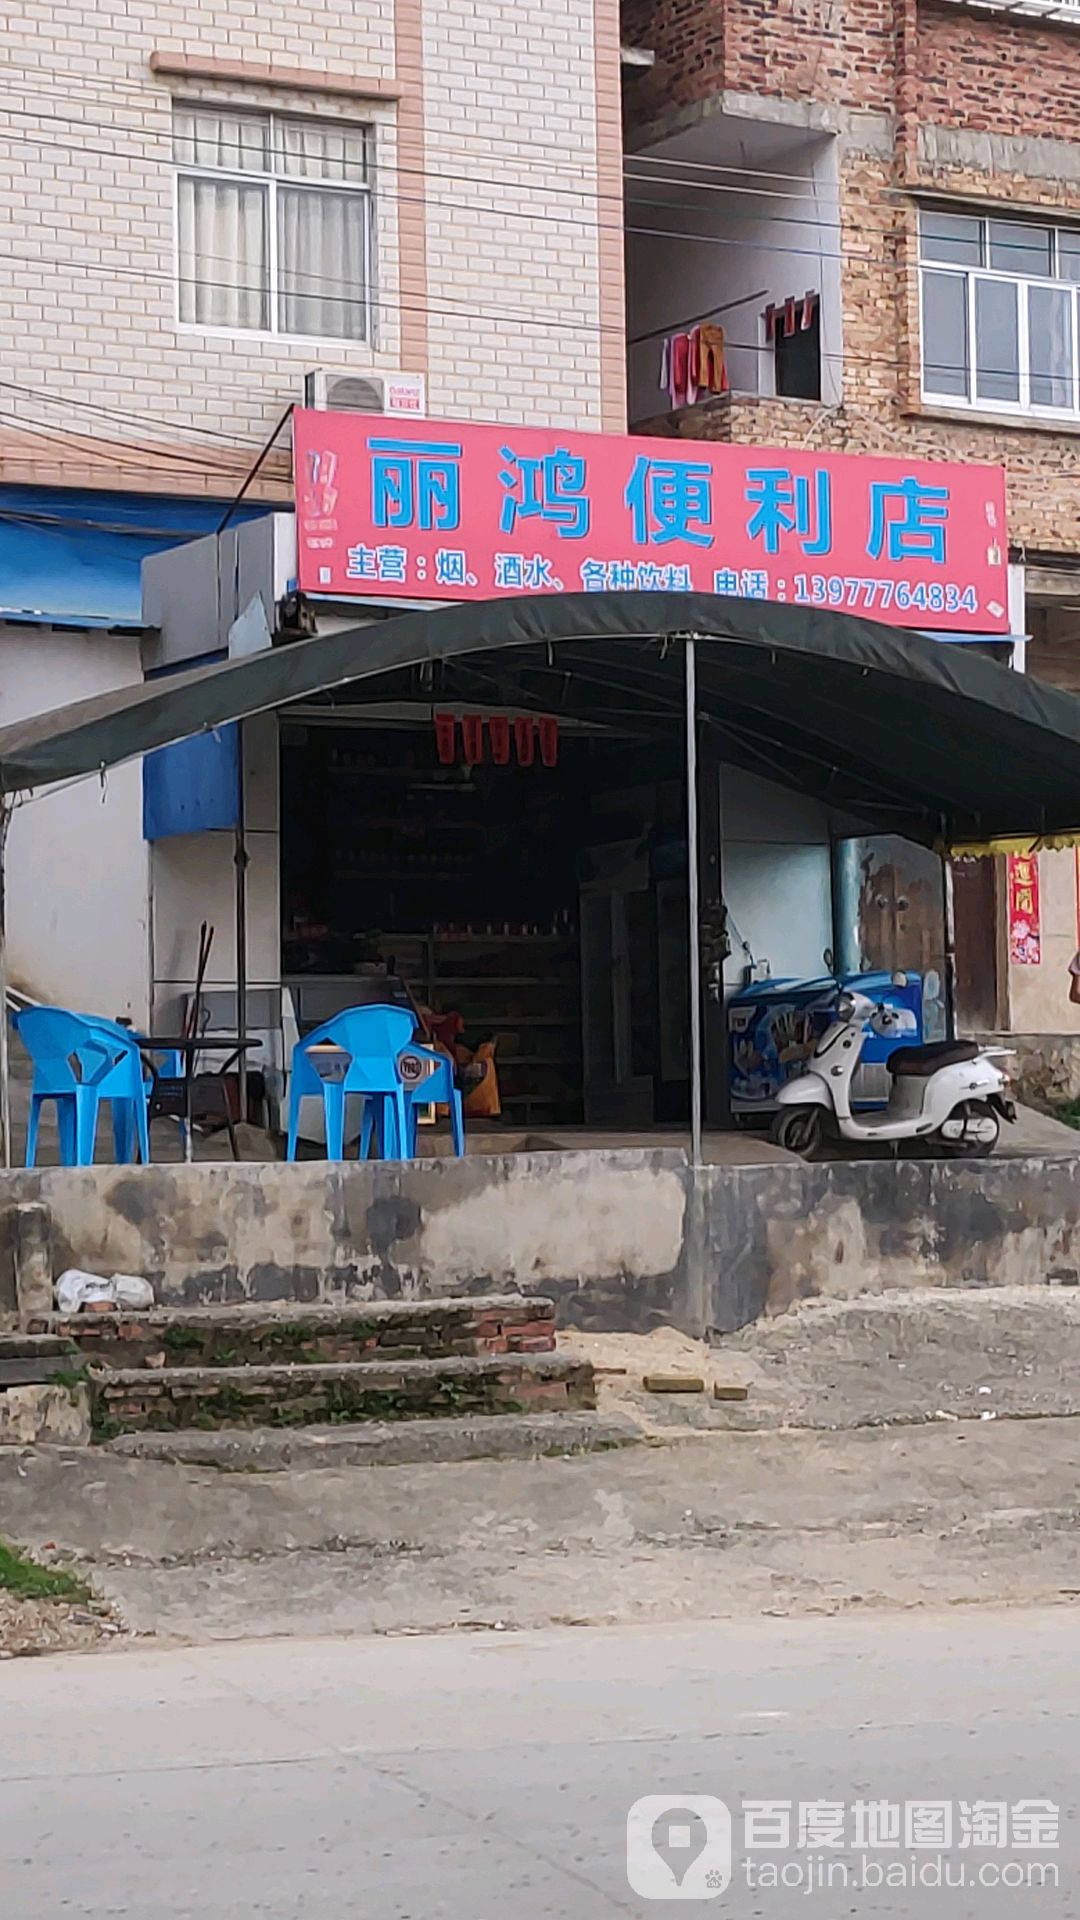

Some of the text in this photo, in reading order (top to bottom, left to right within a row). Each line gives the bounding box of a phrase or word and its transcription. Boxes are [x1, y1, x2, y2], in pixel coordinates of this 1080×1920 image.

[366, 436, 950, 565] 丽鸿便利店
